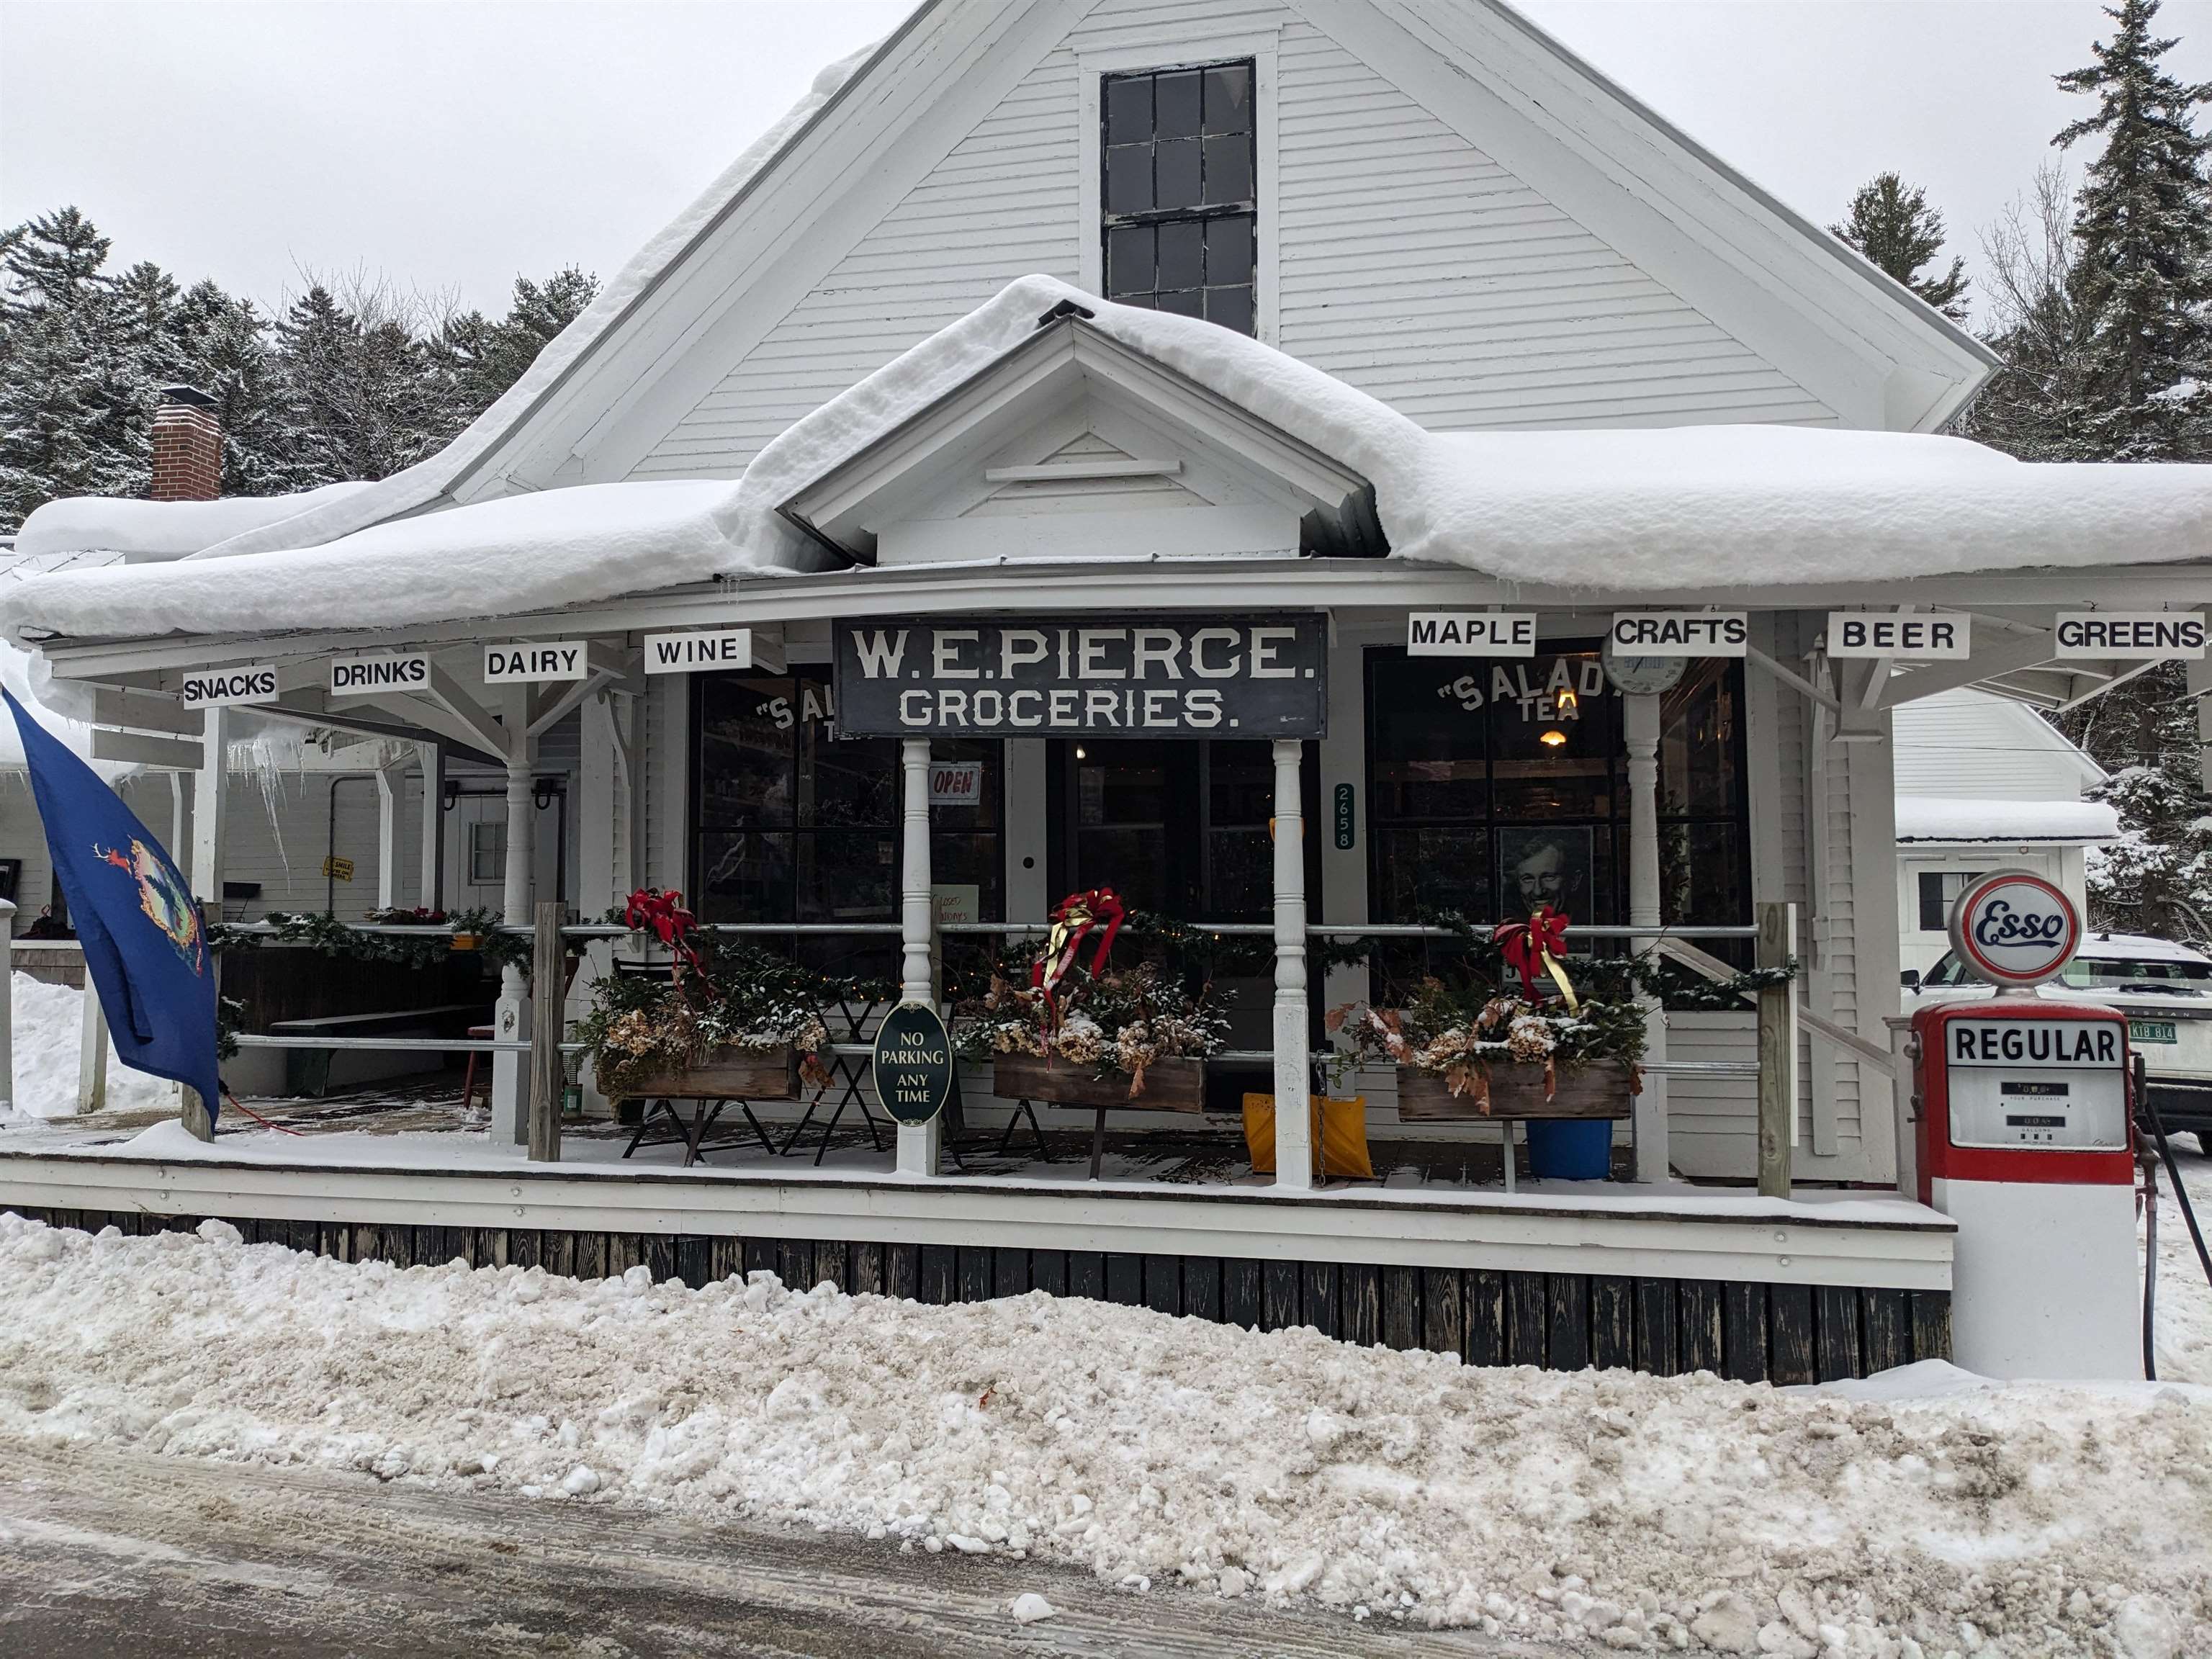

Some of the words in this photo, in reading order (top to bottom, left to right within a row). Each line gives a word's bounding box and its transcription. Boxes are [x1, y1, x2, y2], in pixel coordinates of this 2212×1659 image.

[1411, 620, 1532, 645] MAPLE
[1614, 618, 1748, 644] CRAFTS
[1843, 621, 1954, 649] BEER
[2057, 621, 2206, 648] GREENS
[488, 649, 578, 675] DAIRY
[657, 637, 738, 664] WINE
[333, 659, 426, 687] DRINKS
[184, 672, 275, 701] SNACKS
[899, 690, 1238, 728] GROCERIES.
[1516, 698, 1579, 721] TEA
[934, 770, 974, 793] OPEN
[1976, 900, 2063, 948] Esso
[901, 1032, 924, 1046] NO
[1955, 1028, 2116, 1062] REGULAR
[881, 1050, 945, 1065] PARKING
[897, 1074, 928, 1087] ANY
[896, 1090, 930, 1102] TIME
